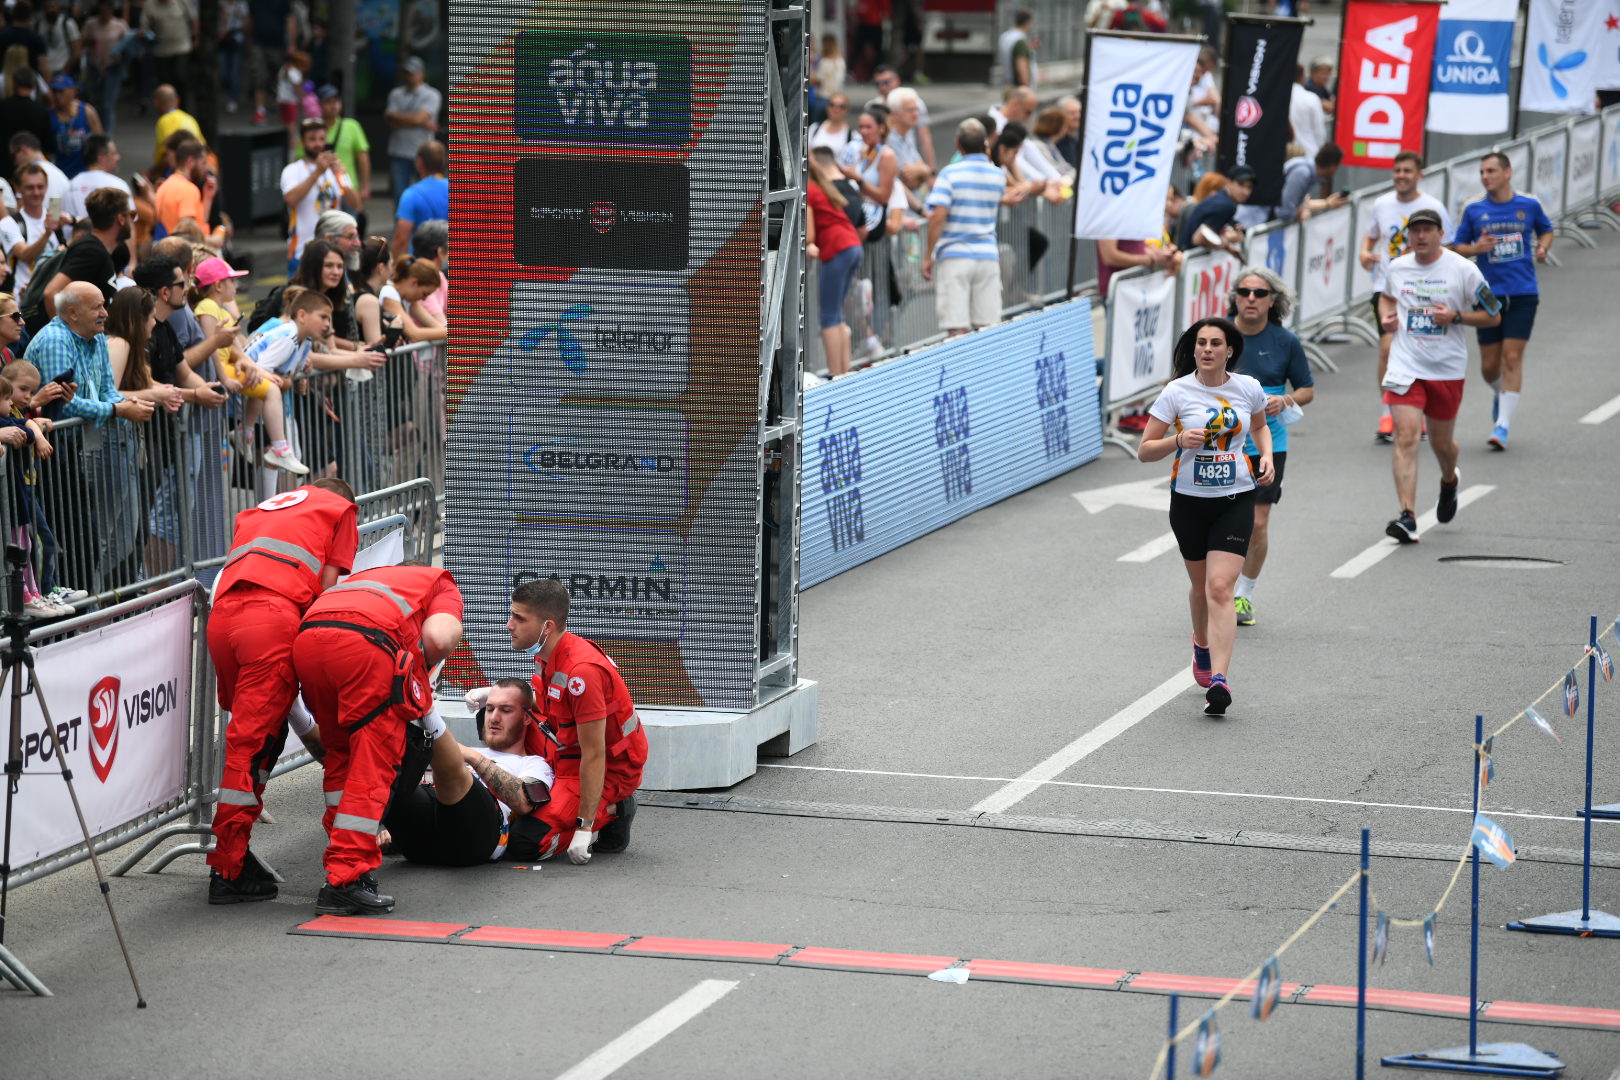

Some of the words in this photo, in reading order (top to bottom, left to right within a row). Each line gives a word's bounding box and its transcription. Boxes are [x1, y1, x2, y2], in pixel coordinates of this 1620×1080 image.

[1235, 129, 1249, 167] ORT
[1245, 38, 1267, 95] VISION
[1436, 64, 1501, 85] UNIQA
[1130, 92, 1174, 185] viva
[1198, 463, 1231, 479] 4829
[512, 570, 673, 602] RMIN
[19, 716, 82, 769] PORT
[123, 677, 178, 730] VISION
